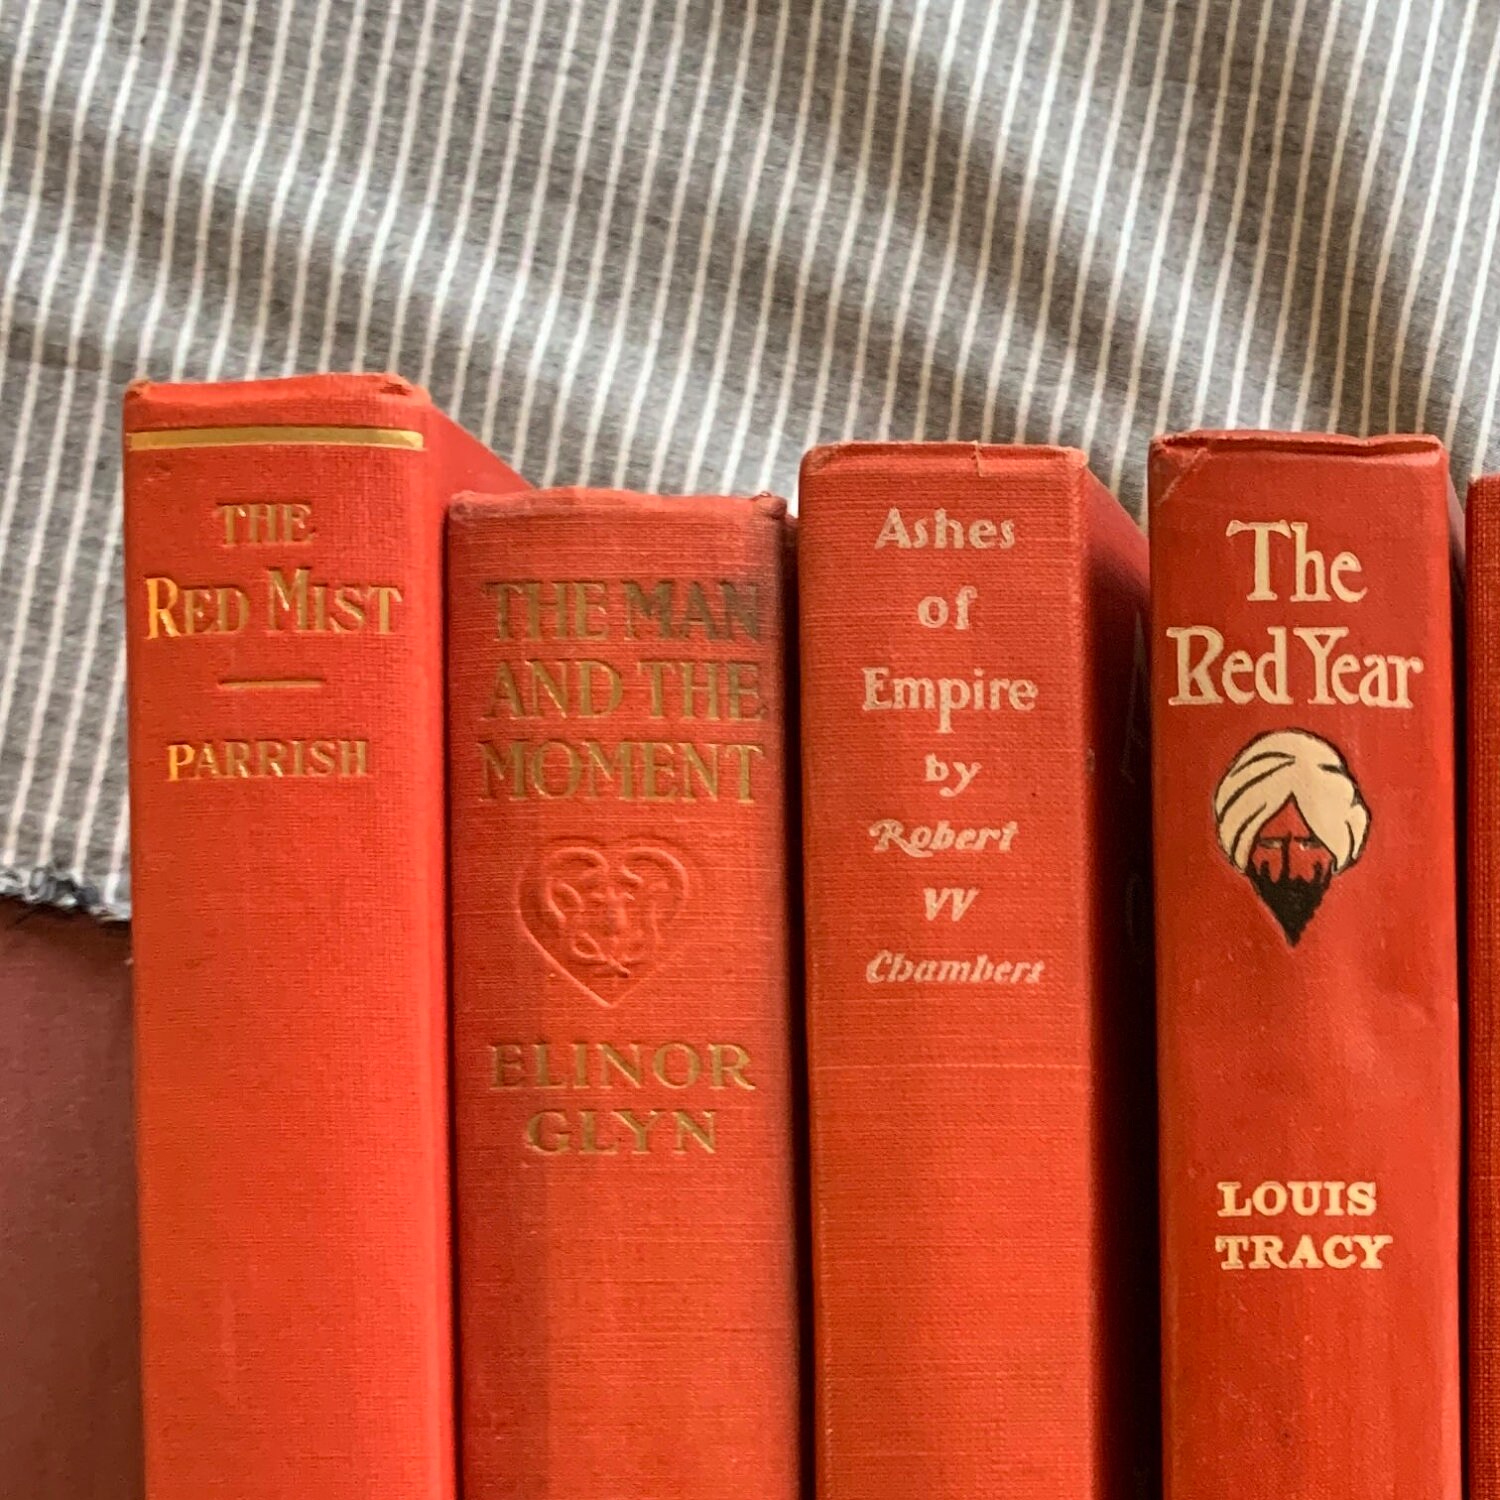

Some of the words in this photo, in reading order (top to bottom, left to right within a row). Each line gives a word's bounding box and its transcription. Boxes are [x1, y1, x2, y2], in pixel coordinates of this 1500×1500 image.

[217, 503, 317, 546] THE
[875, 507, 1016, 551] Ashes
[1227, 520, 1369, 603] The
[483, 580, 623, 643] THE
[624, 580, 762, 642] MAN
[917, 587, 978, 630] of
[1167, 626, 1298, 707] Red
[1296, 626, 1425, 710] Year
[484, 660, 624, 721] AND
[637, 660, 770, 722] THE
[861, 668, 1040, 734] Empire
[167, 740, 370, 784] PARRISH
[481, 742, 764, 803] MOMENT
[926, 755, 981, 798] by
[869, 820, 1018, 858] Robert
[866, 953, 1046, 986] Chambers
[489, 1042, 757, 1092] ELINOR
[523, 1110, 718, 1154] GLYN
[1217, 1181, 1377, 1218] LOUIS
[1214, 1235, 1392, 1272] TRACY
